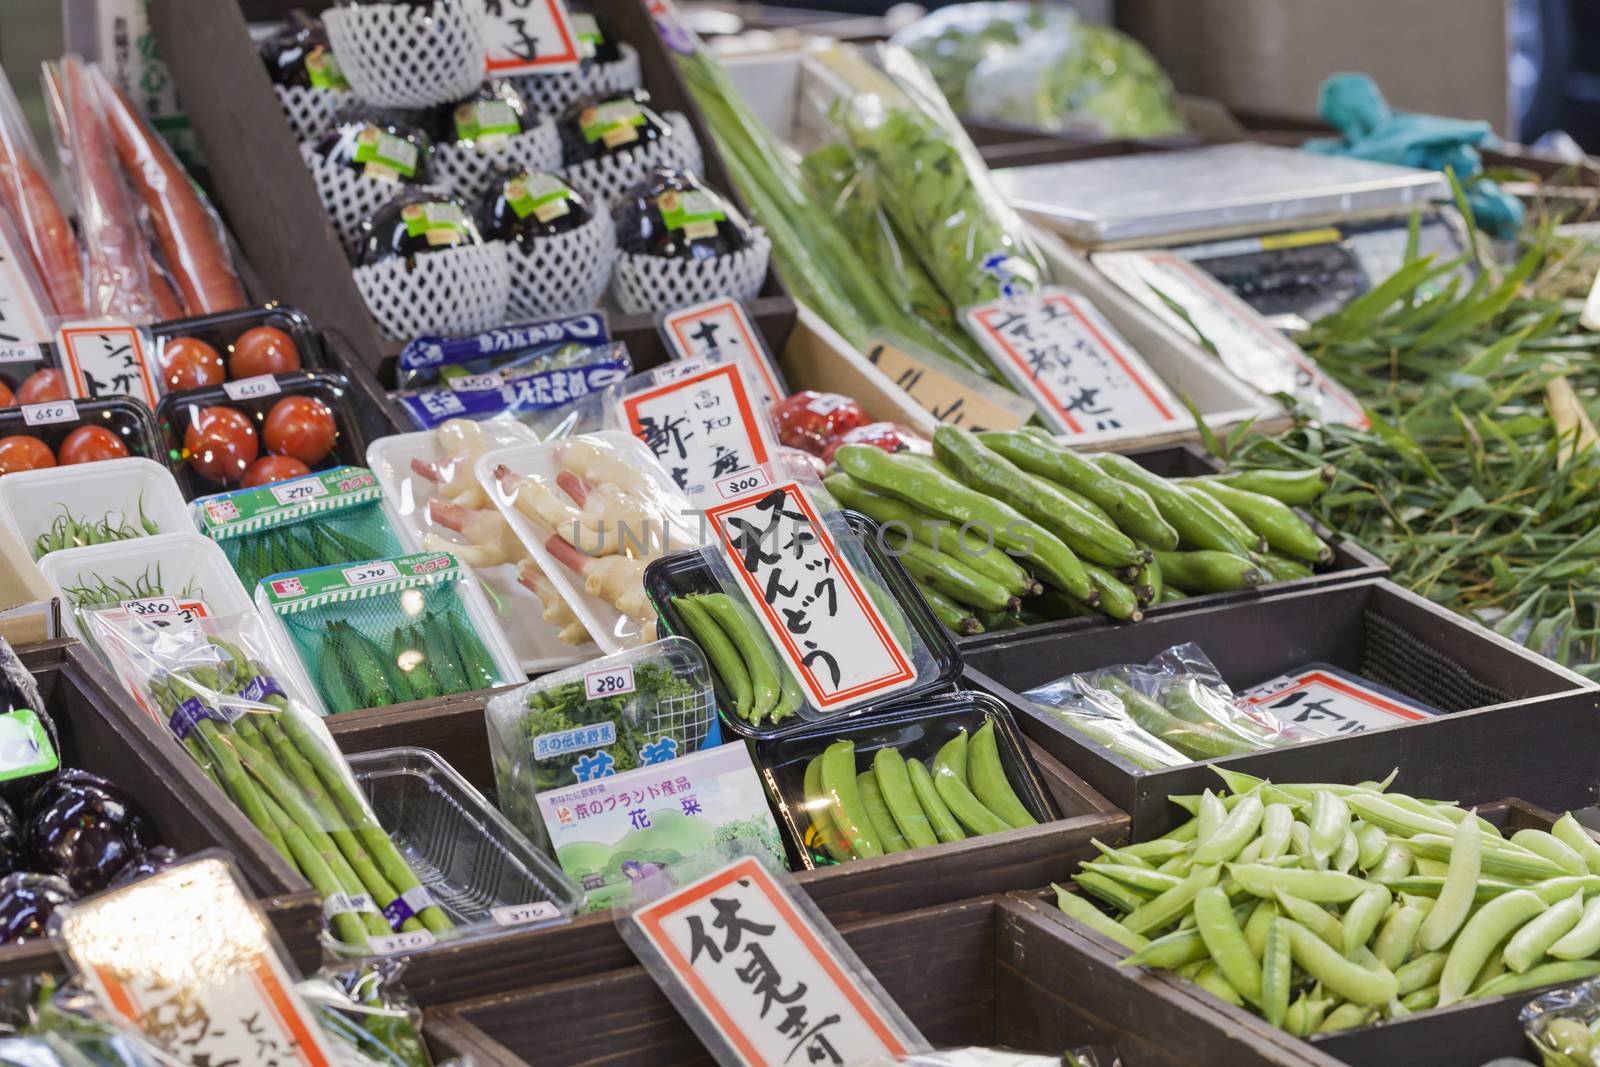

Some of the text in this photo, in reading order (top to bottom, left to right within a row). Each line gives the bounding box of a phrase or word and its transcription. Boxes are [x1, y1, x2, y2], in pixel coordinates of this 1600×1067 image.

[484, 0, 540, 61] 子
[239, 383, 267, 395] 650
[34, 408, 64, 421] 650
[285, 486, 314, 500] 270
[729, 477, 759, 493] 300
[756, 489, 838, 617] スナック
[357, 568, 386, 581] 270
[409, 556, 451, 575] オクラ
[727, 517, 842, 692] えんどう
[596, 675, 625, 693] 280
[574, 776, 692, 820] 京のブランド産品
[628, 794, 703, 830] 花 菜
